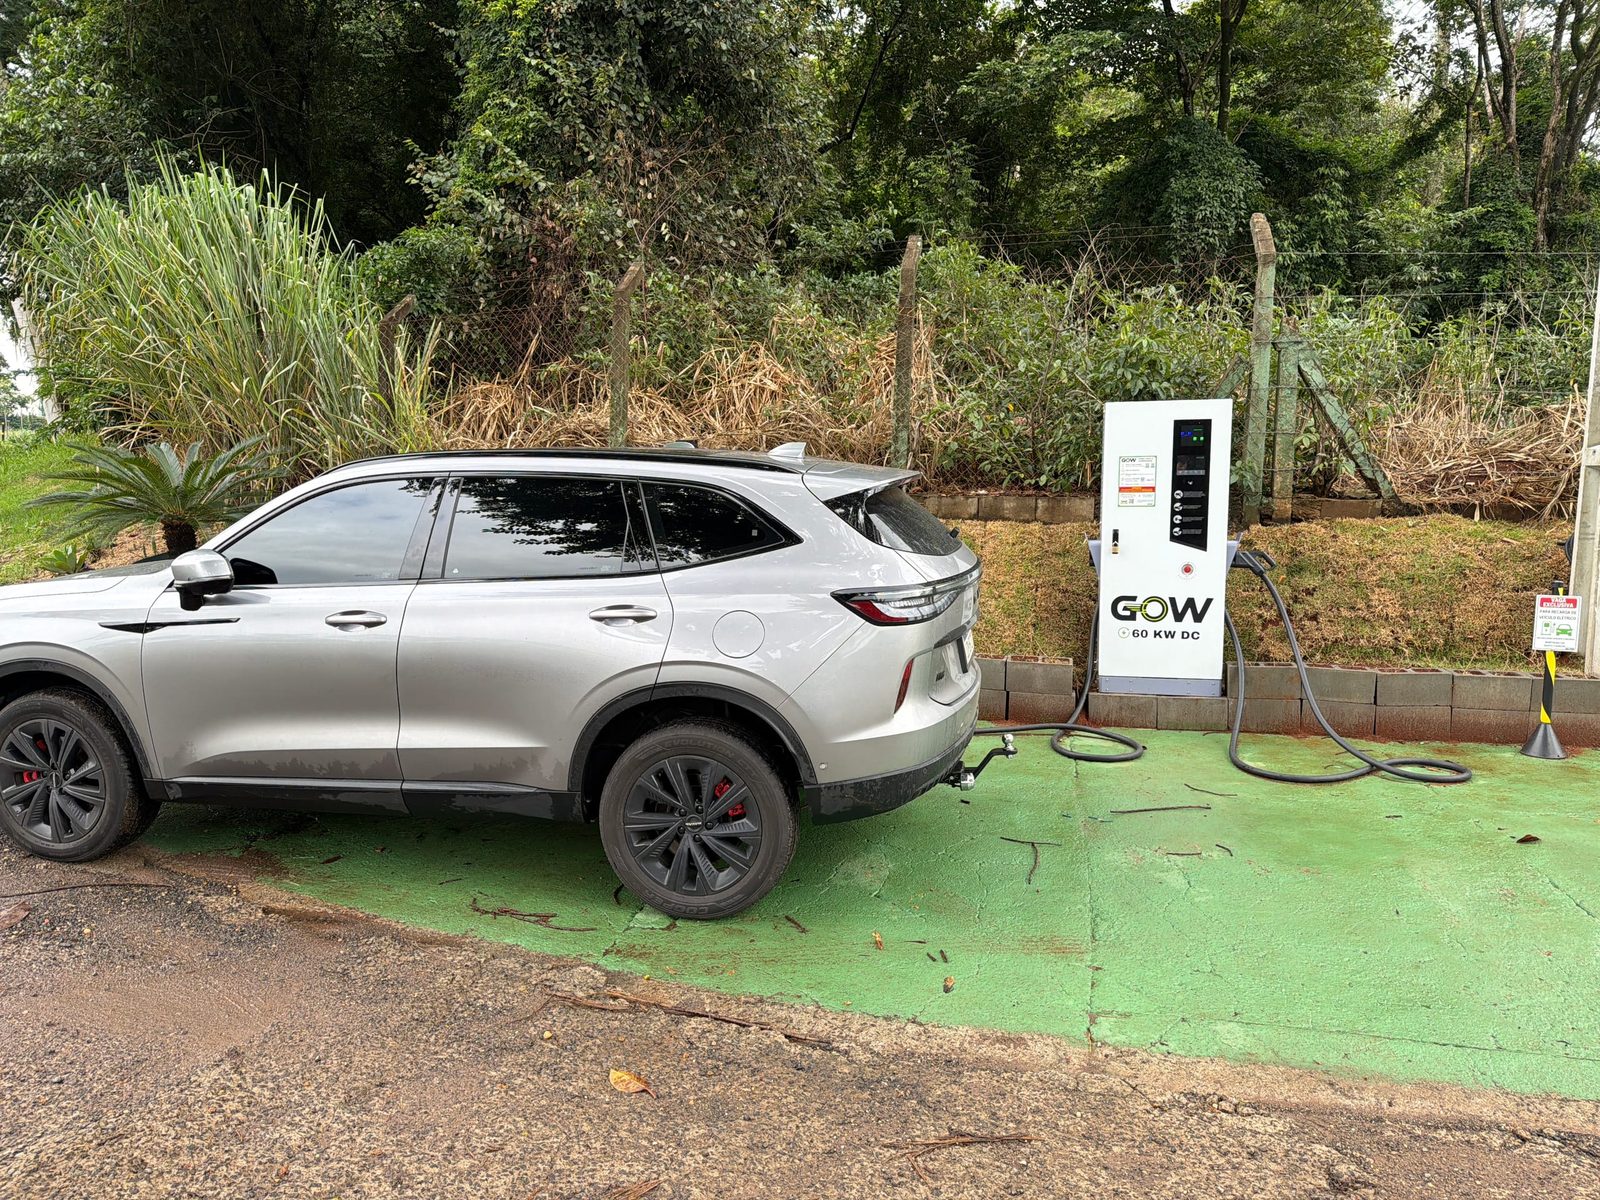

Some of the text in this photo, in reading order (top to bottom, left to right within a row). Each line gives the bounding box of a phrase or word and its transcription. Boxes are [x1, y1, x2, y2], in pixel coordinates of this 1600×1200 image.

[1111, 595, 1214, 623] GOW
[1132, 629, 1200, 640] 60 KW DC
[664, 739, 735, 757] EVOLUTION
